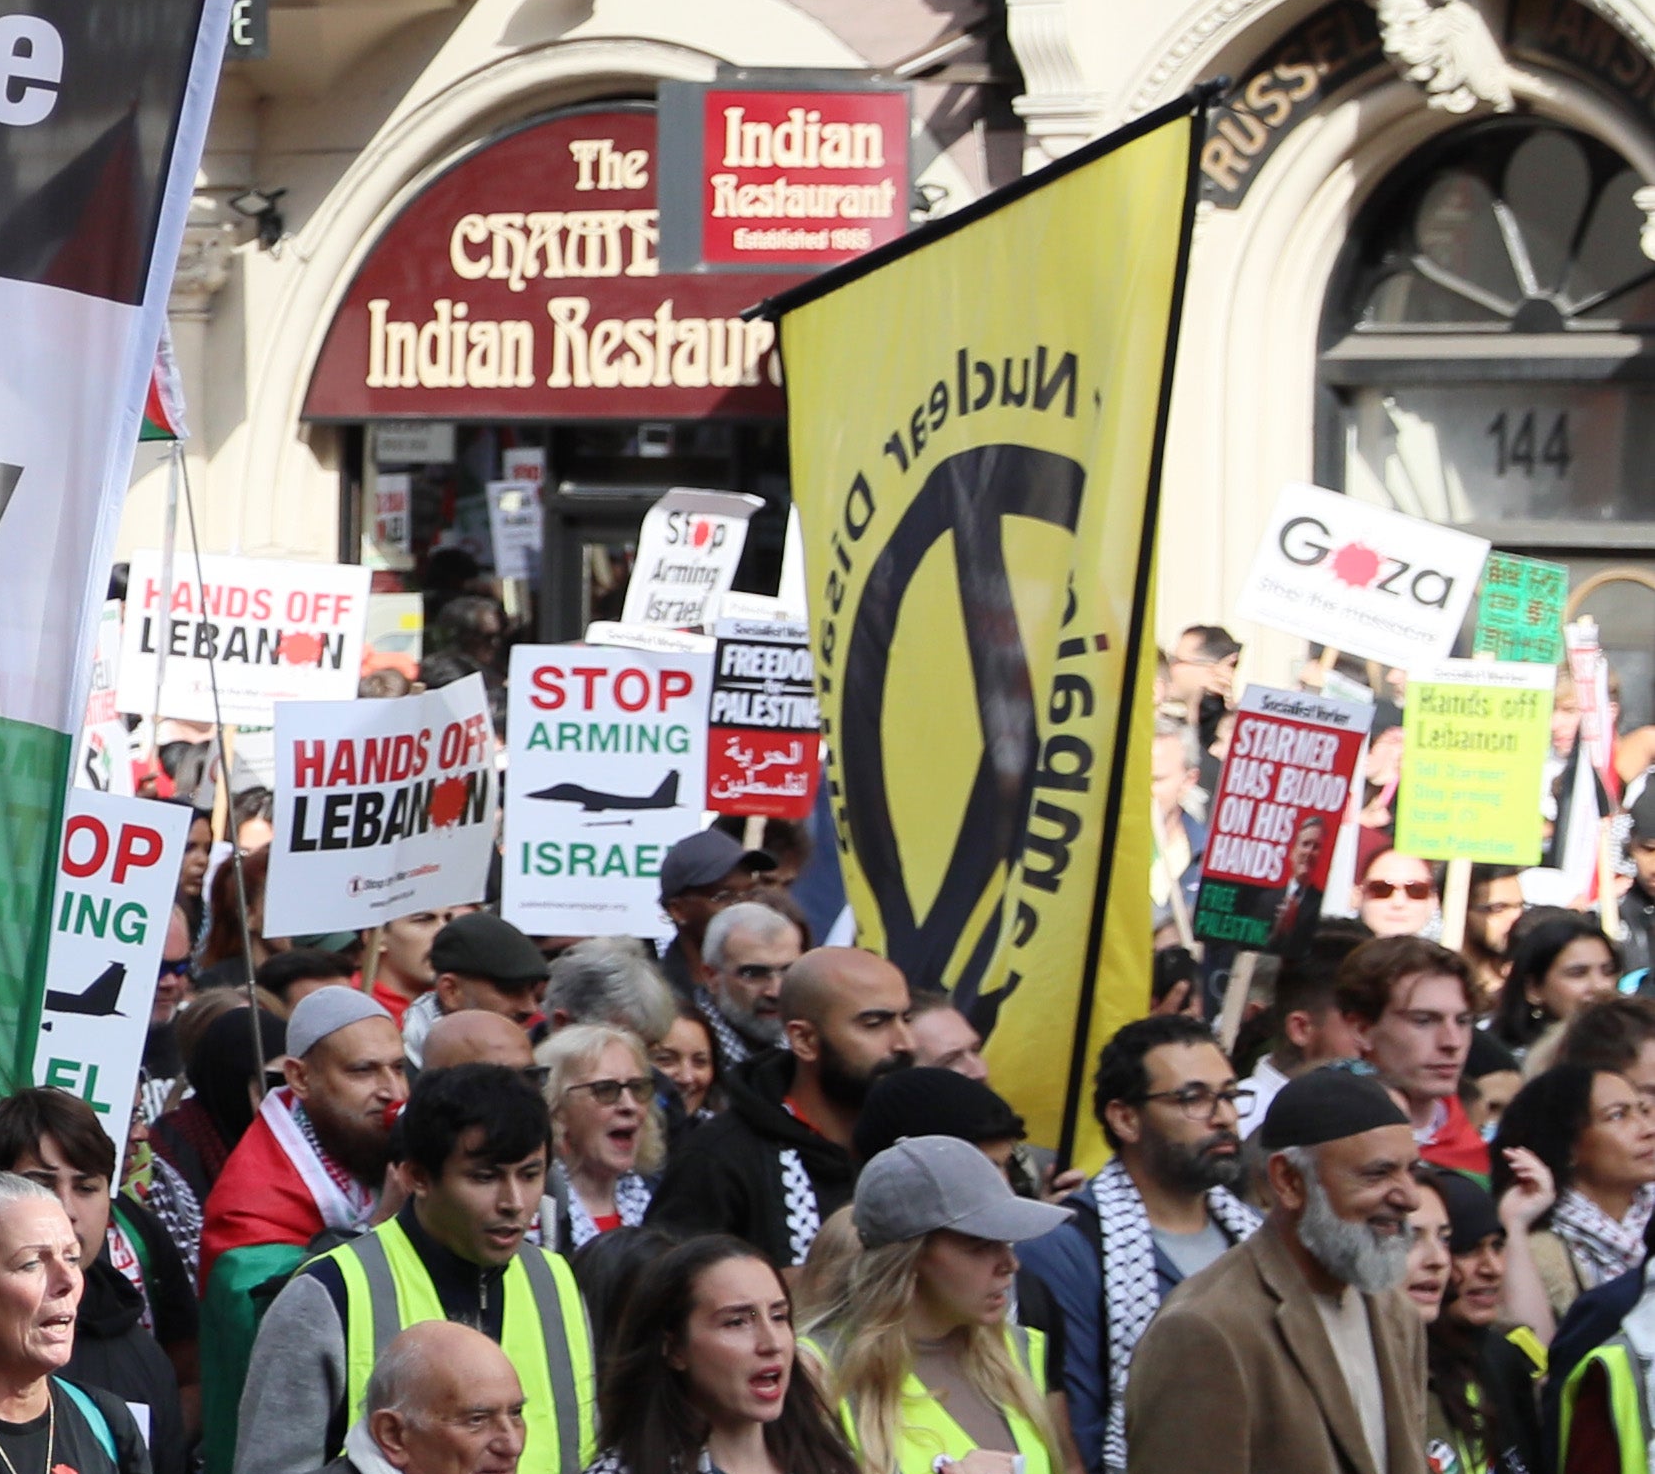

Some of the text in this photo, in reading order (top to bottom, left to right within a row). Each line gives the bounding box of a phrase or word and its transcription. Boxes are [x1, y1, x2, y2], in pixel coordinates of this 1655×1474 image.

[722, 106, 885, 169] Indian
[570, 139, 649, 191] The
[710, 174, 895, 220] Restaurant
[734, 227, 828, 251] Established
[366, 299, 535, 390] Indian
[1487, 408, 1575, 479] 144
[651, 558, 722, 590] Arming
[142, 577, 354, 625] HANDS OFF
[529, 664, 693, 713] STOP
[1416, 687, 1540, 721] Hands off
[292, 712, 490, 789] HANDS OFF
[524, 721, 692, 755] ARMING
[1235, 718, 1340, 771] STARMER
[1416, 721, 1520, 753] Lebanon
[1225, 757, 1347, 813] HAS BLOOD
[1218, 795, 1298, 845] ON HIS
[1209, 834, 1287, 882] HANDS
